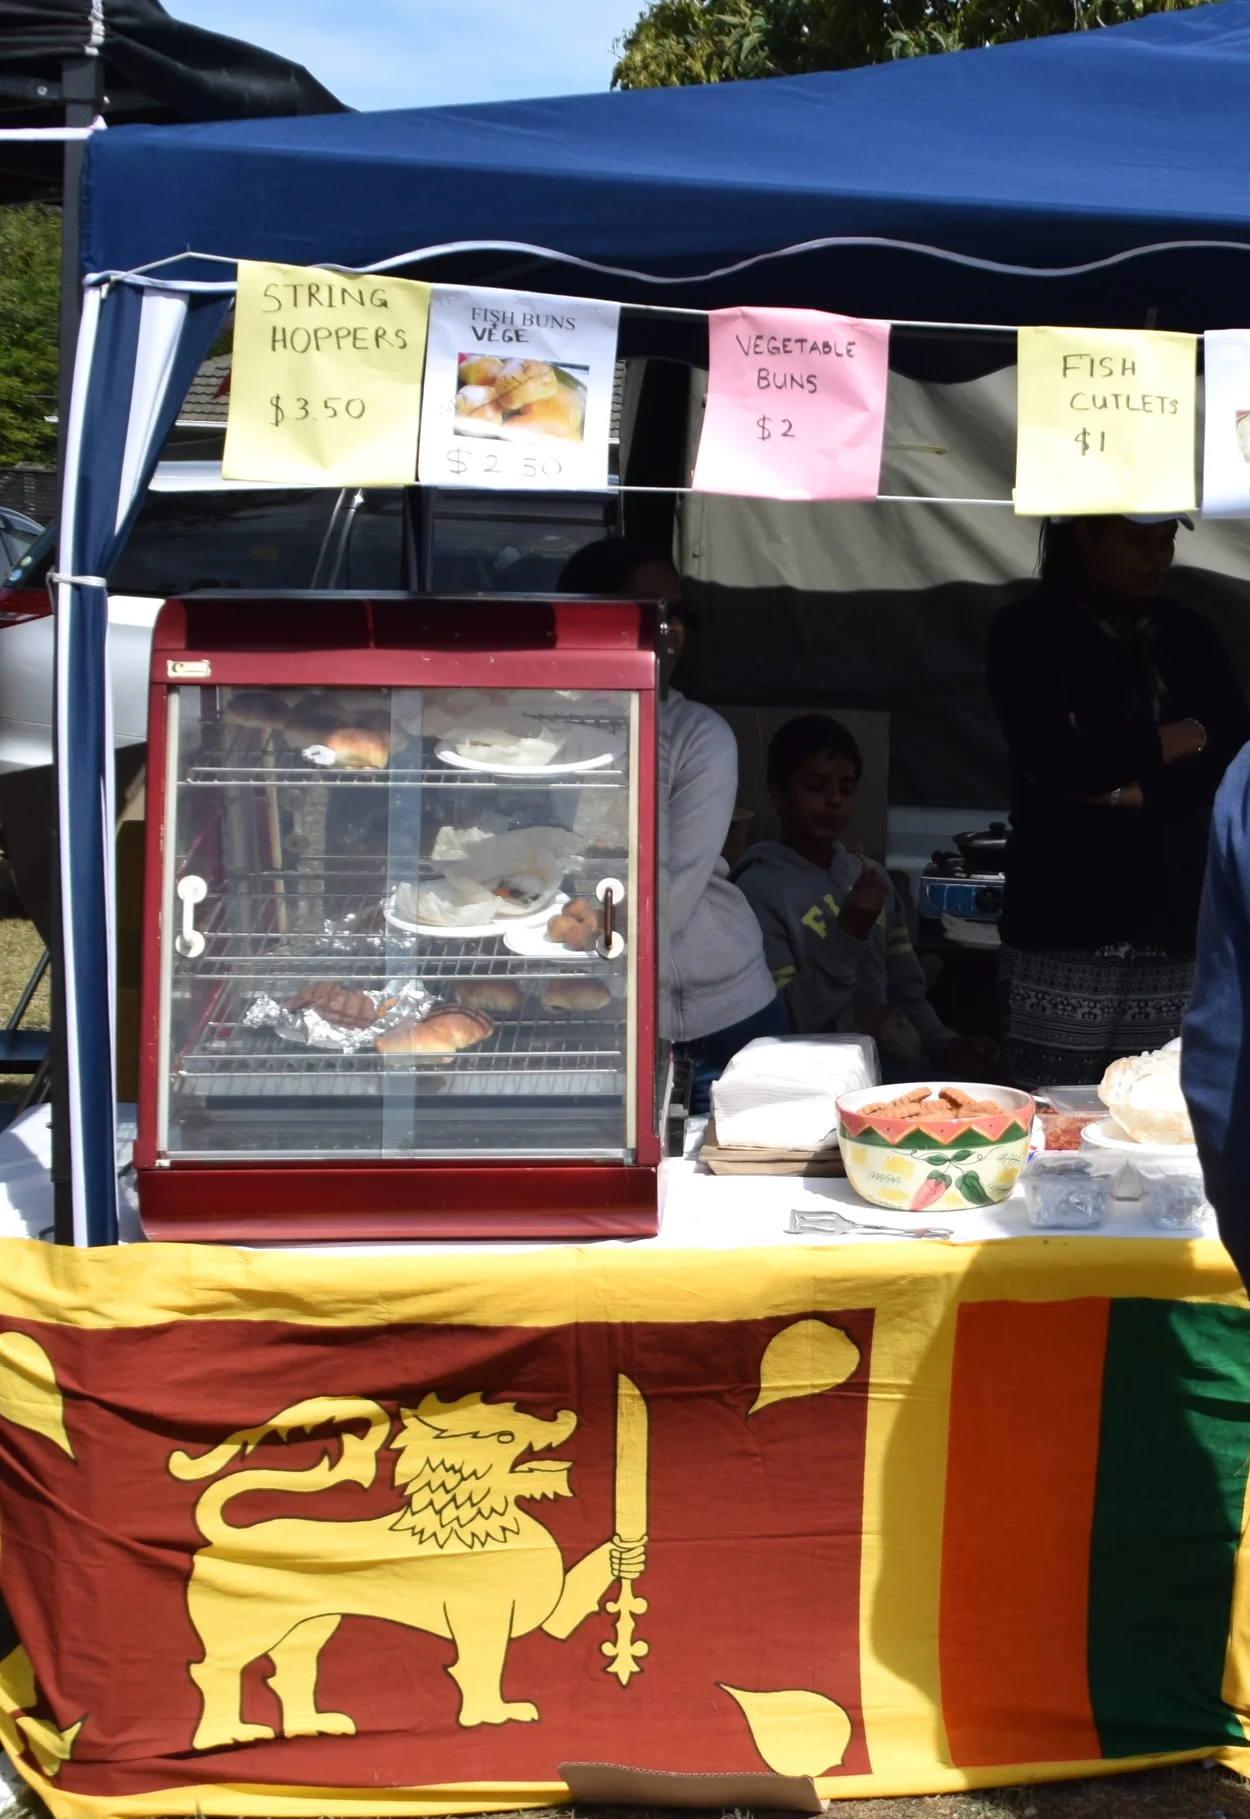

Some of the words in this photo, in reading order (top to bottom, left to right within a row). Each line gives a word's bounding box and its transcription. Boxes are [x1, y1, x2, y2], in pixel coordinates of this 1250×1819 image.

[262, 283, 389, 313] STRING
[470, 306, 516, 326] FISH
[521, 312, 577, 331] BUNS
[271, 325, 408, 354] HOPPERS
[470, 325, 530, 343] VEGE
[735, 333, 856, 360] VEGETABLE
[1061, 353, 1137, 379] FISH
[756, 367, 818, 395] BUNS
[268, 393, 367, 428] $3.50
[1069, 391, 1180, 415] CUTLETS
[1073, 426, 1107, 457] $1
